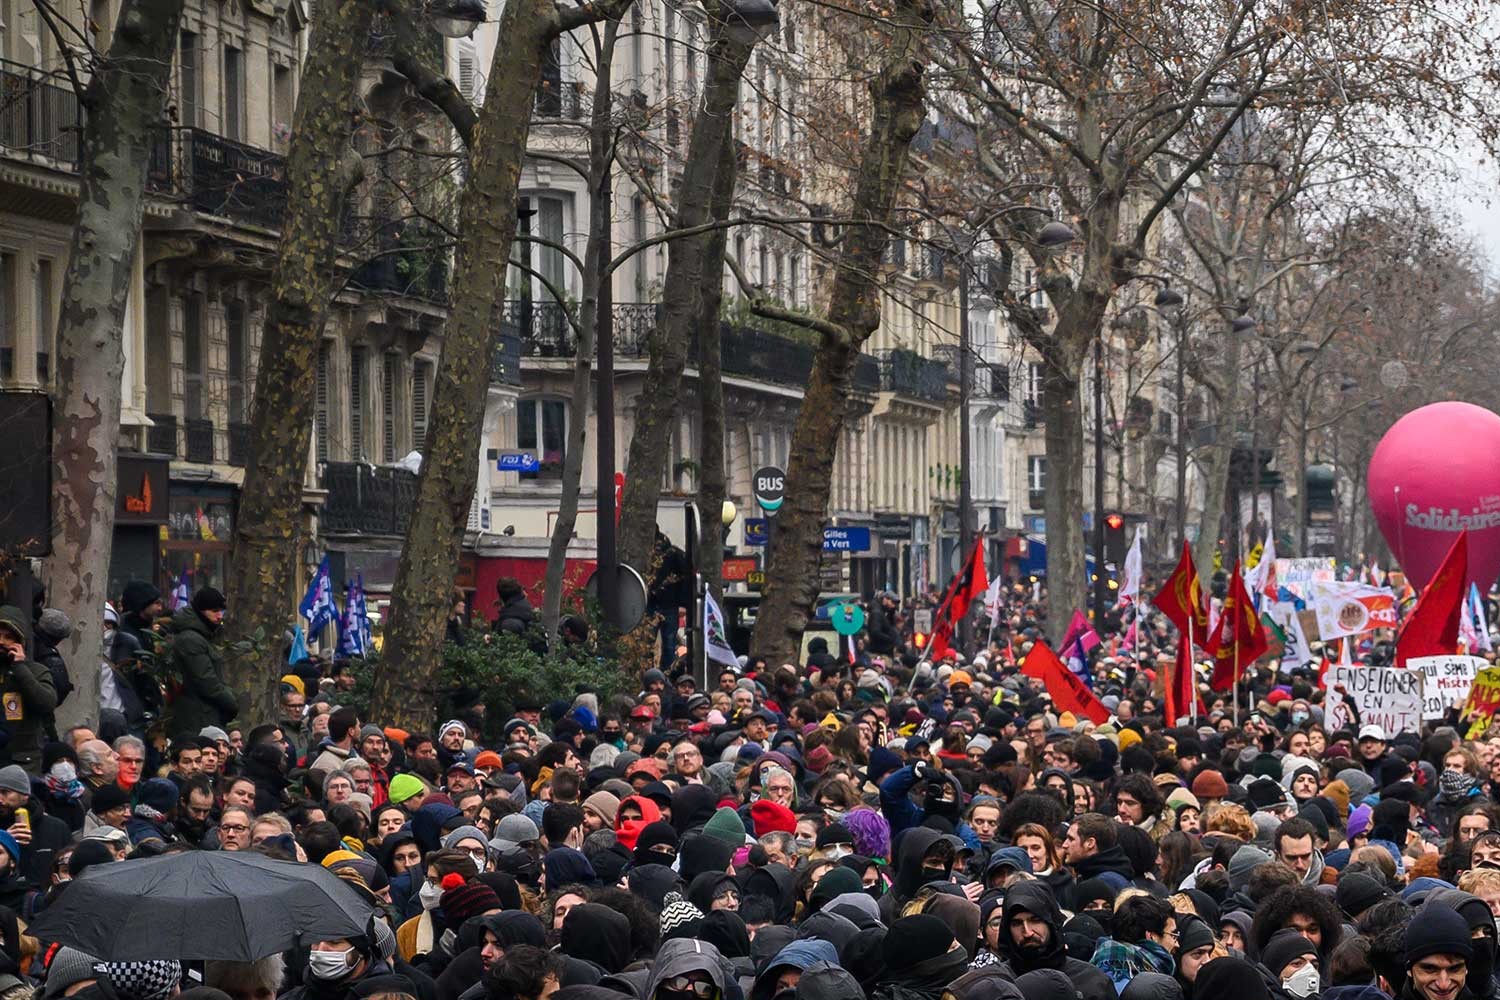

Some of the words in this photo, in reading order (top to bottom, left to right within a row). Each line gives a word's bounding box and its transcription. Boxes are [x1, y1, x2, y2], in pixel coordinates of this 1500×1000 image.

[758, 477, 783, 491] BUS
[832, 540, 850, 548] Vert
[1418, 661, 1437, 685] qui
[1336, 667, 1418, 695] ENSEIGNER
[1363, 694, 1383, 708] EN
